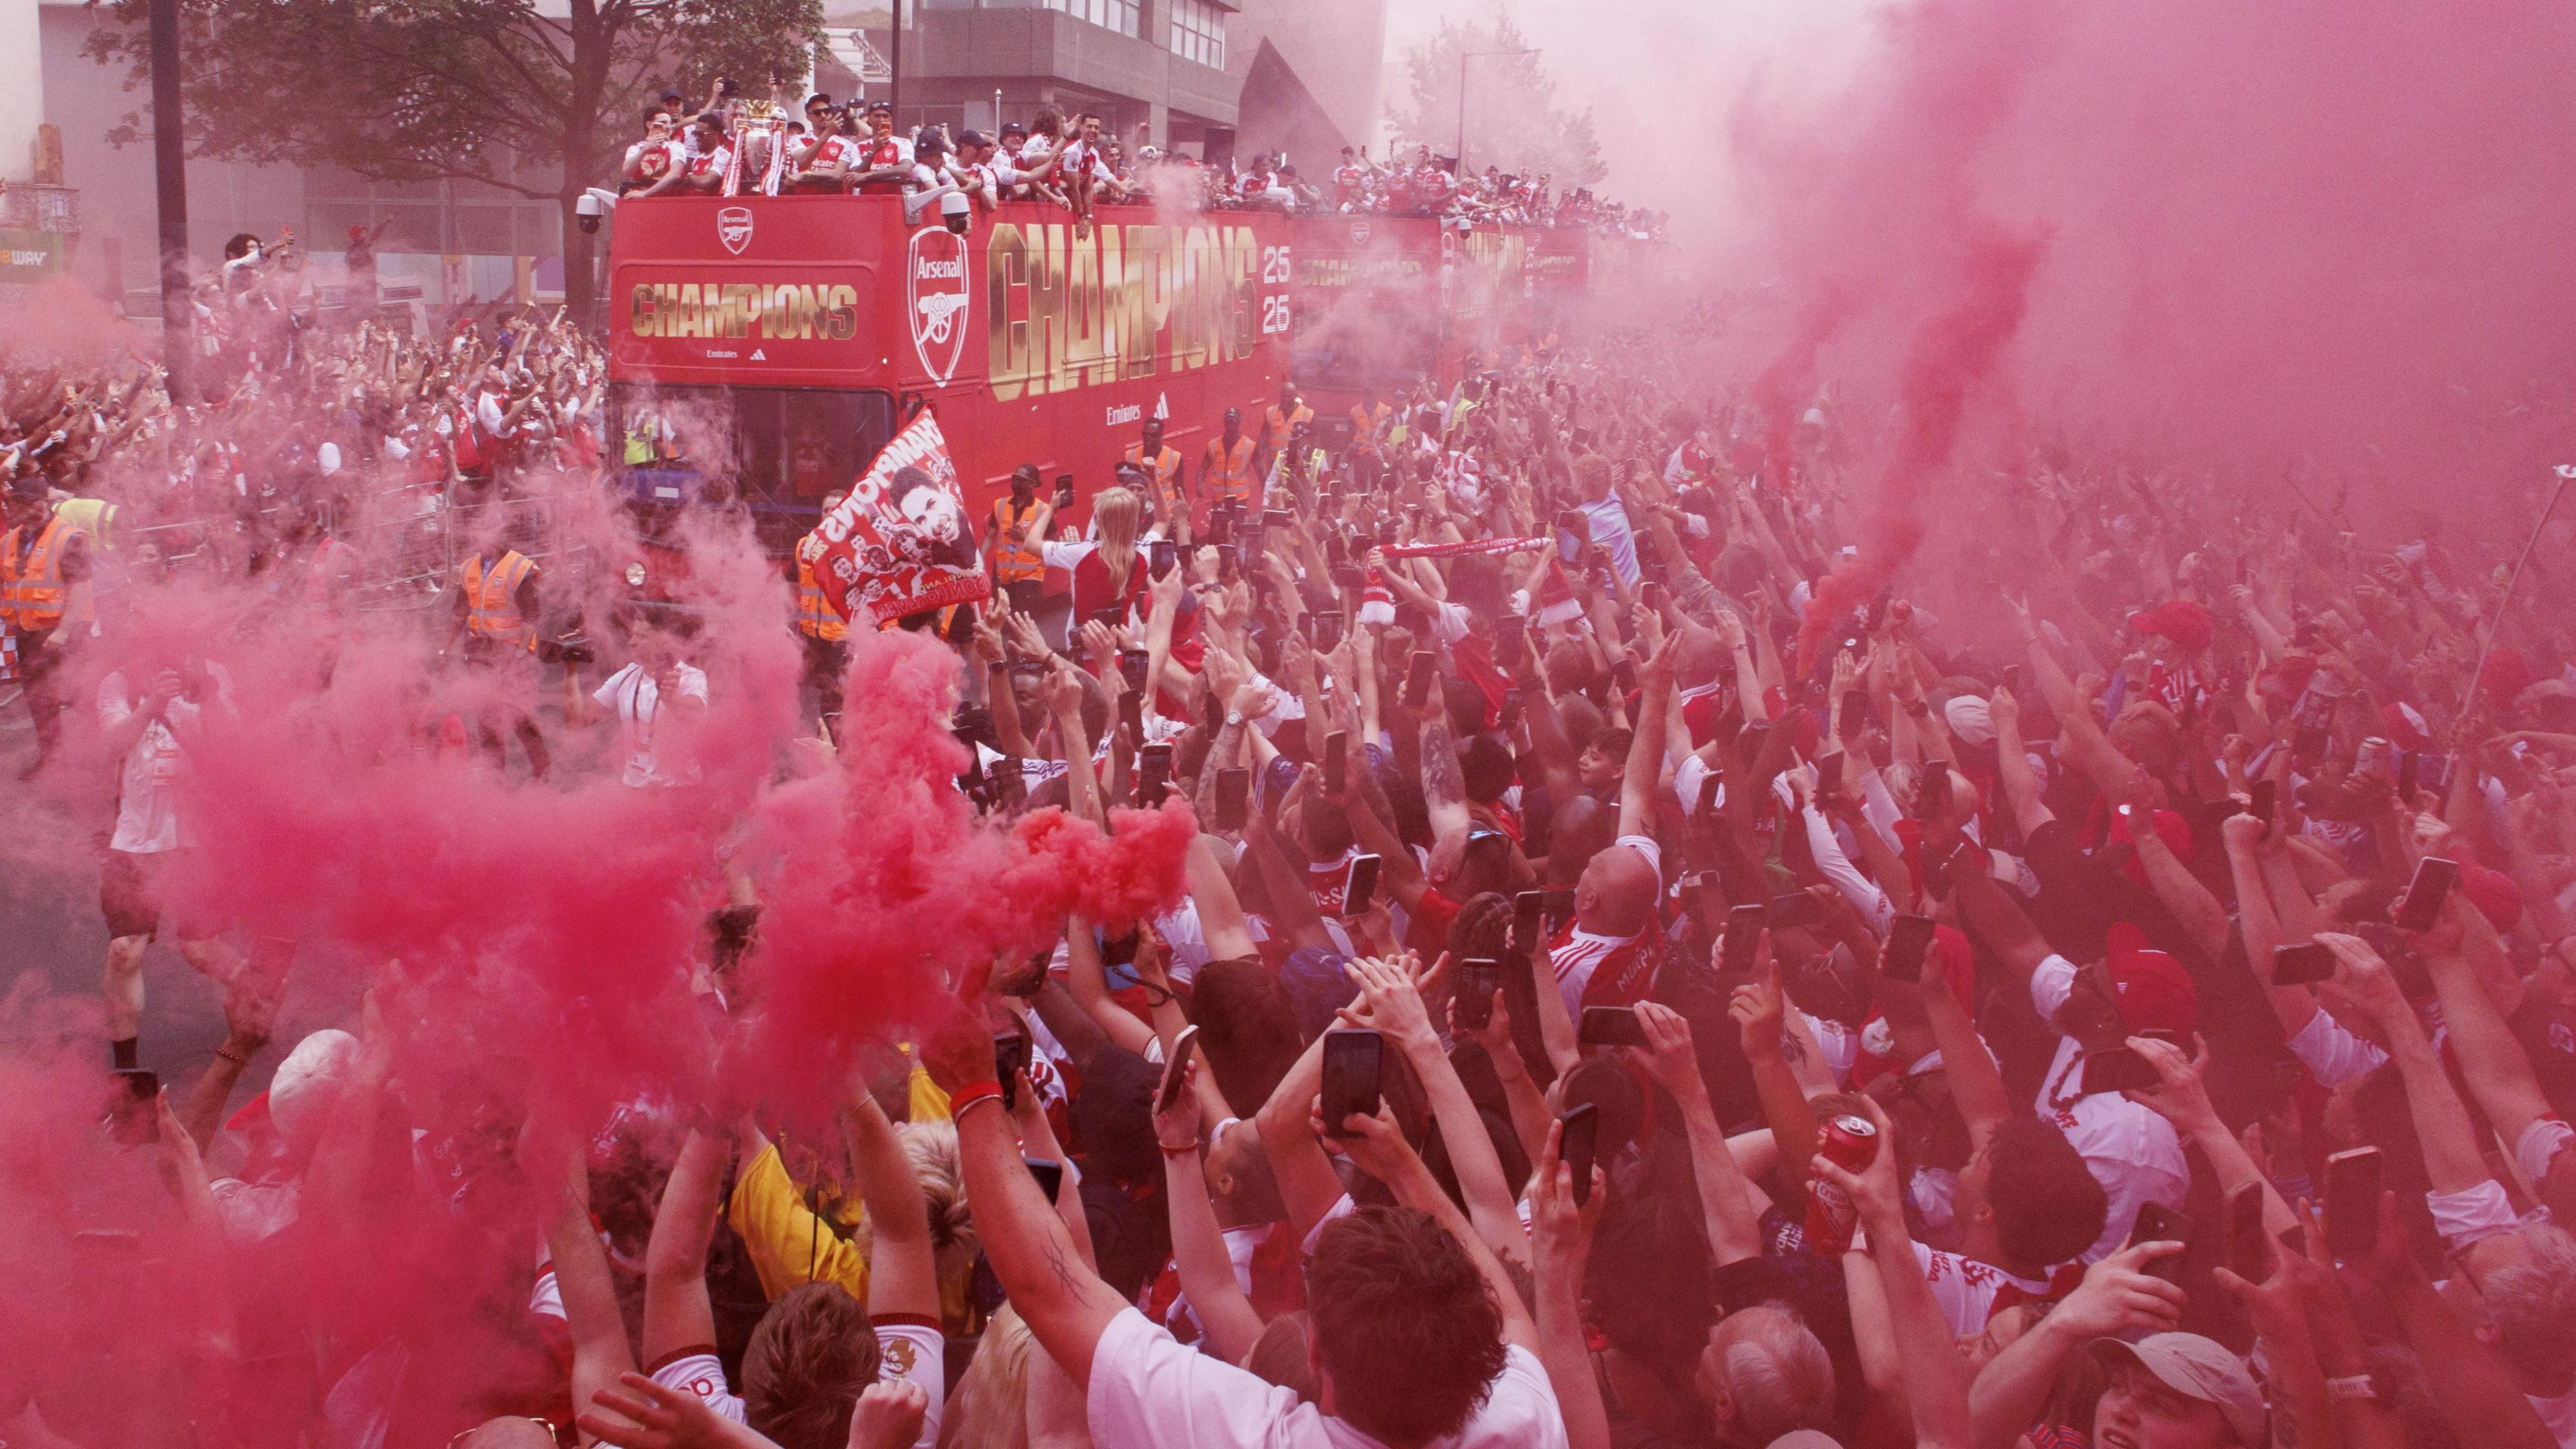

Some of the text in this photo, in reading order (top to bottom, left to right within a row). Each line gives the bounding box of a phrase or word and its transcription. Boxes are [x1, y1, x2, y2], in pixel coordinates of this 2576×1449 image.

[916, 255, 961, 279] Arsenal
[1263, 246, 1291, 284] 25
[632, 283, 858, 340] CHAMPIONS
[988, 223, 1258, 402] CHAMPIONS
[1263, 294, 1290, 334] 26
[706, 349, 738, 359] Emirates
[1107, 404, 1140, 426] Emirates
